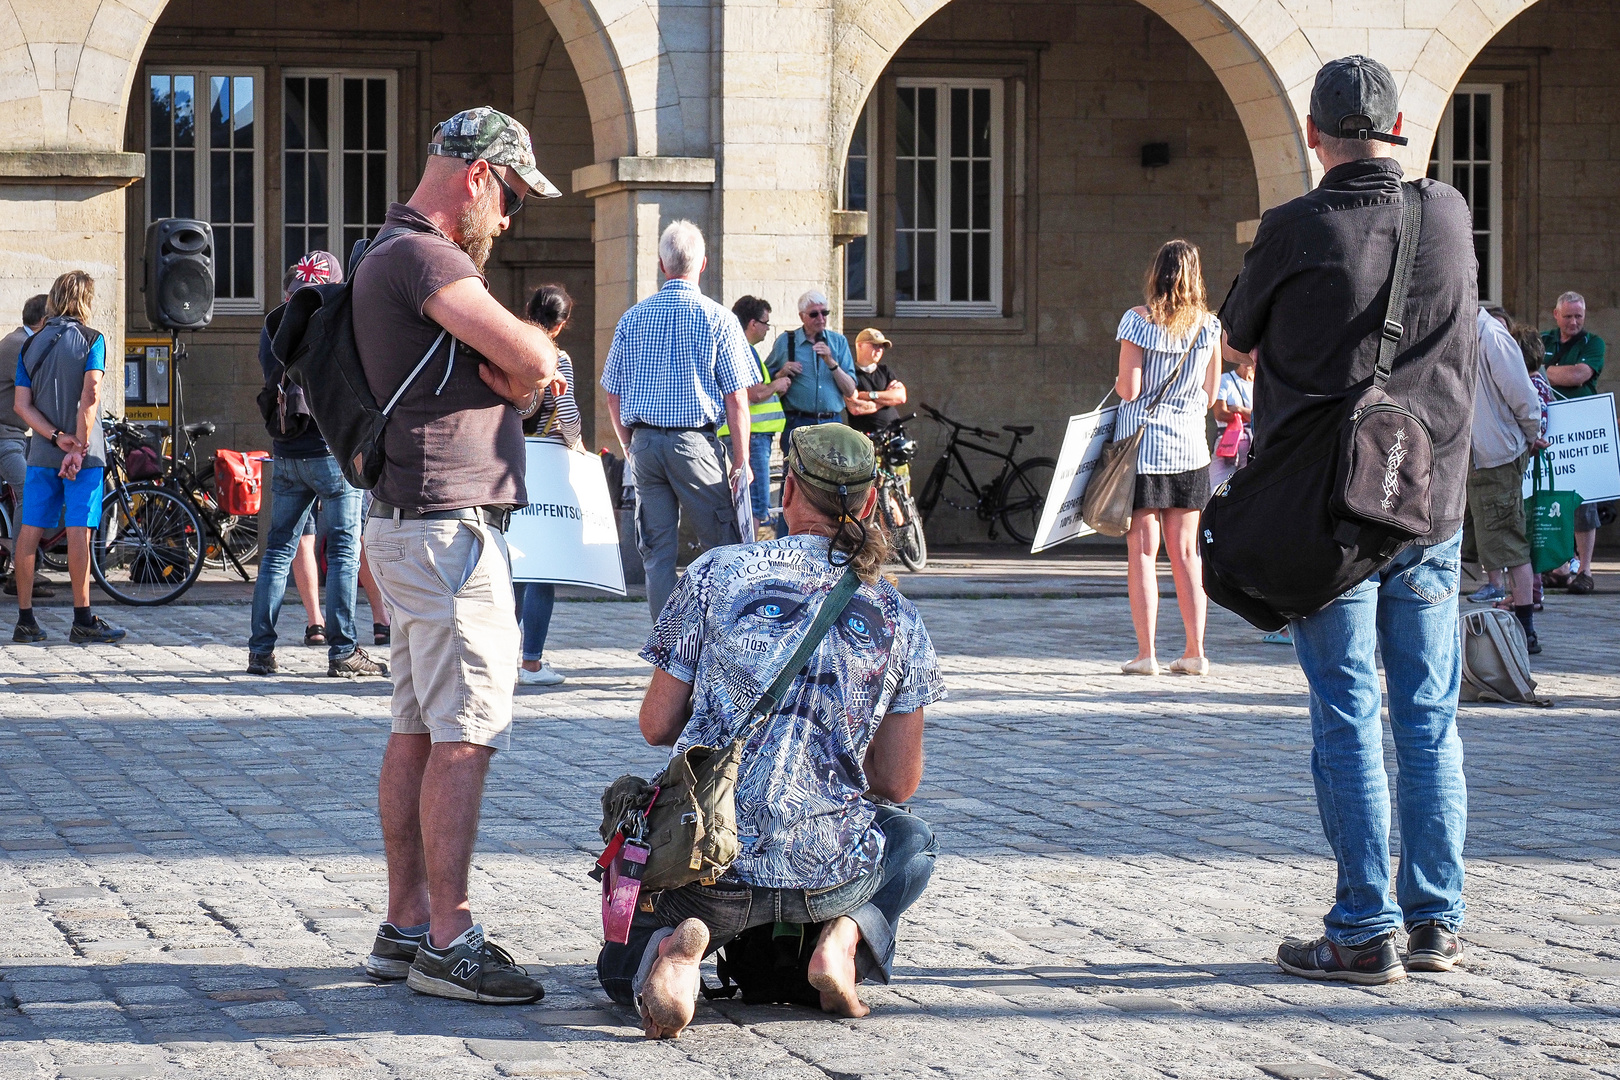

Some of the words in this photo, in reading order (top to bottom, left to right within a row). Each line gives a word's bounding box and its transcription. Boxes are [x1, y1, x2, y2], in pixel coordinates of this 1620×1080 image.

[1548, 434, 1565, 445] DIE
[1568, 428, 1606, 443] KINDER
[1559, 447, 1589, 460] NICHT
[1593, 443, 1609, 455] DIE
[1554, 464, 1576, 476] UNS
